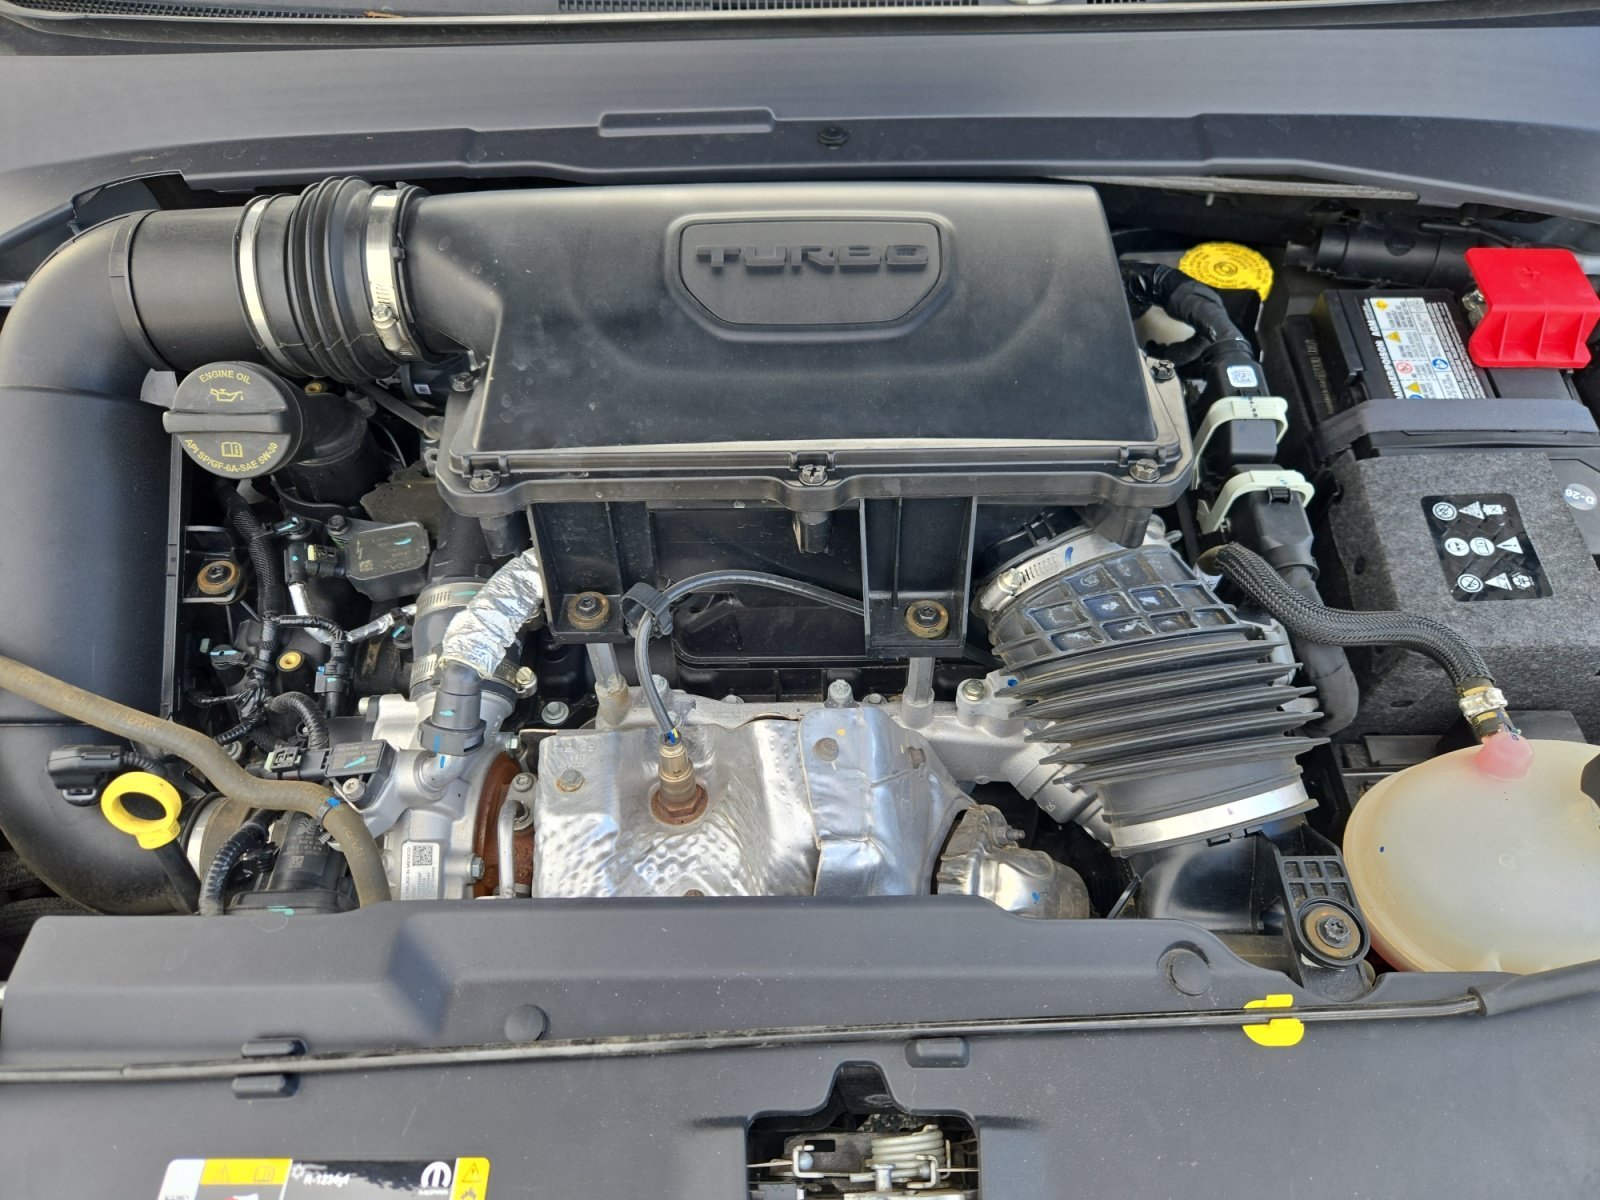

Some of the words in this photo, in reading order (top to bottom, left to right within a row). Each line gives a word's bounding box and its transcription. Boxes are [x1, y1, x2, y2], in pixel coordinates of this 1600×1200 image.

[696, 245, 928, 273] TURBO
[199, 370, 234, 384] ENGINE
[235, 373, 251, 384] OIL
[184, 438, 199, 454] API
[258, 442, 278, 464] 5W-30
[1565, 488, 1595, 505] D-26
